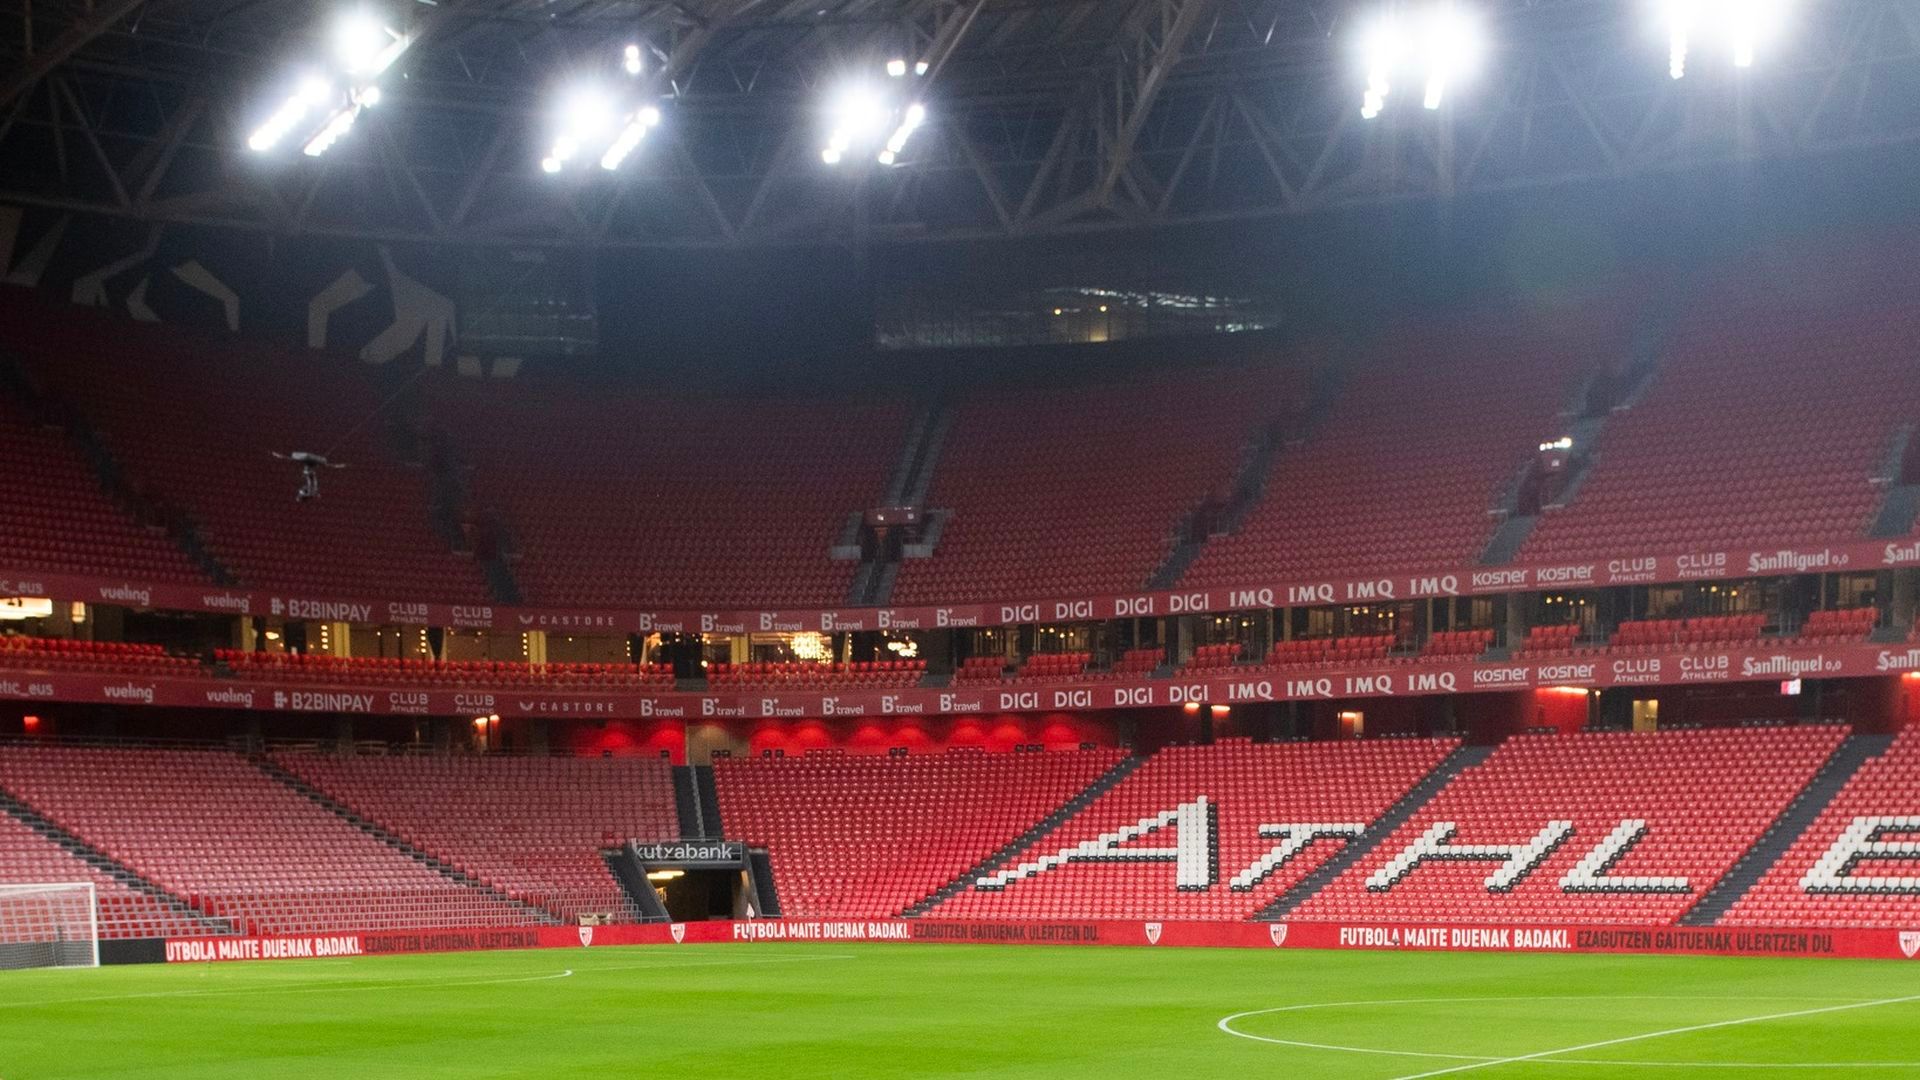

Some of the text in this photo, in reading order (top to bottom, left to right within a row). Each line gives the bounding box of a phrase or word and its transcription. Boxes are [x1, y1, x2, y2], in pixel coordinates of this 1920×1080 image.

[1608, 557, 1657, 573] CLUB
[1677, 552, 1726, 568] CLUB
[1609, 572, 1656, 583] ATHLETIC
[1678, 568, 1725, 578] ATHLETIC
[0, 580, 43, 595] c_eus
[1348, 579, 1395, 599] IMQ
[1410, 575, 1459, 595] IMQ
[100, 584, 151, 605] vueling
[1229, 588, 1275, 607] IMQ
[1289, 584, 1336, 603] IMQ
[203, 594, 251, 611] vueling
[288, 599, 372, 621] B2BINPAY
[389, 602, 428, 615] CLUB
[1056, 601, 1092, 619] DIGI
[1115, 598, 1153, 616] DIGI
[1170, 594, 1209, 612] DIGI
[390, 614, 428, 624] ATHLETIC
[452, 606, 492, 618] CLUB
[1001, 605, 1040, 623] DIGI
[453, 618, 492, 628] ATHLETIC
[540, 616, 614, 626] CASTORE
[654, 621, 683, 632] travel
[715, 623, 744, 633] travel
[774, 621, 802, 631] travel
[835, 620, 863, 630] travel
[892, 618, 919, 629] travel
[950, 616, 977, 626] travel
[1613, 659, 1661, 673] CLUB
[1680, 655, 1729, 670] CLUB
[1408, 671, 1457, 692] IMQ
[1613, 672, 1660, 683] ATHLETIC
[1681, 670, 1728, 680] ATHLETIC
[104, 682, 154, 702] vueling
[1228, 681, 1274, 700] IMQ
[1287, 678, 1333, 697] IMQ
[1346, 675, 1394, 695] IMQ
[207, 687, 253, 707] vueling
[389, 692, 428, 705] CLUB
[454, 694, 494, 706] CLUB
[1000, 692, 1038, 709] DIGI
[1055, 690, 1092, 708] DIGI
[1115, 687, 1152, 705] DIGI
[1169, 684, 1208, 702] DIGI
[292, 692, 374, 712] B2BINPAY
[390, 704, 428, 714] ATHLETIC
[540, 702, 614, 712] CASTORE
[895, 703, 922, 713] travel
[953, 701, 980, 711] travel
[456, 706, 494, 715] ATHLETIC
[655, 706, 683, 717] travel
[717, 705, 744, 716] travel
[776, 706, 804, 716] travel
[836, 705, 864, 715] travel
[733, 922, 911, 939] FUTBOLA MAITE DUENAK BADAKI.
[1340, 927, 1571, 949] FUTBOLA MAITE DUENAK BADAKI.
[165, 936, 362, 961] UTBOLA MAITE DUENAK BADAKI.
[1577, 930, 1650, 949] EZAGUTZEN
[1655, 931, 1732, 951] GAITUENAK
[1736, 933, 1808, 952] ULERTZEN
